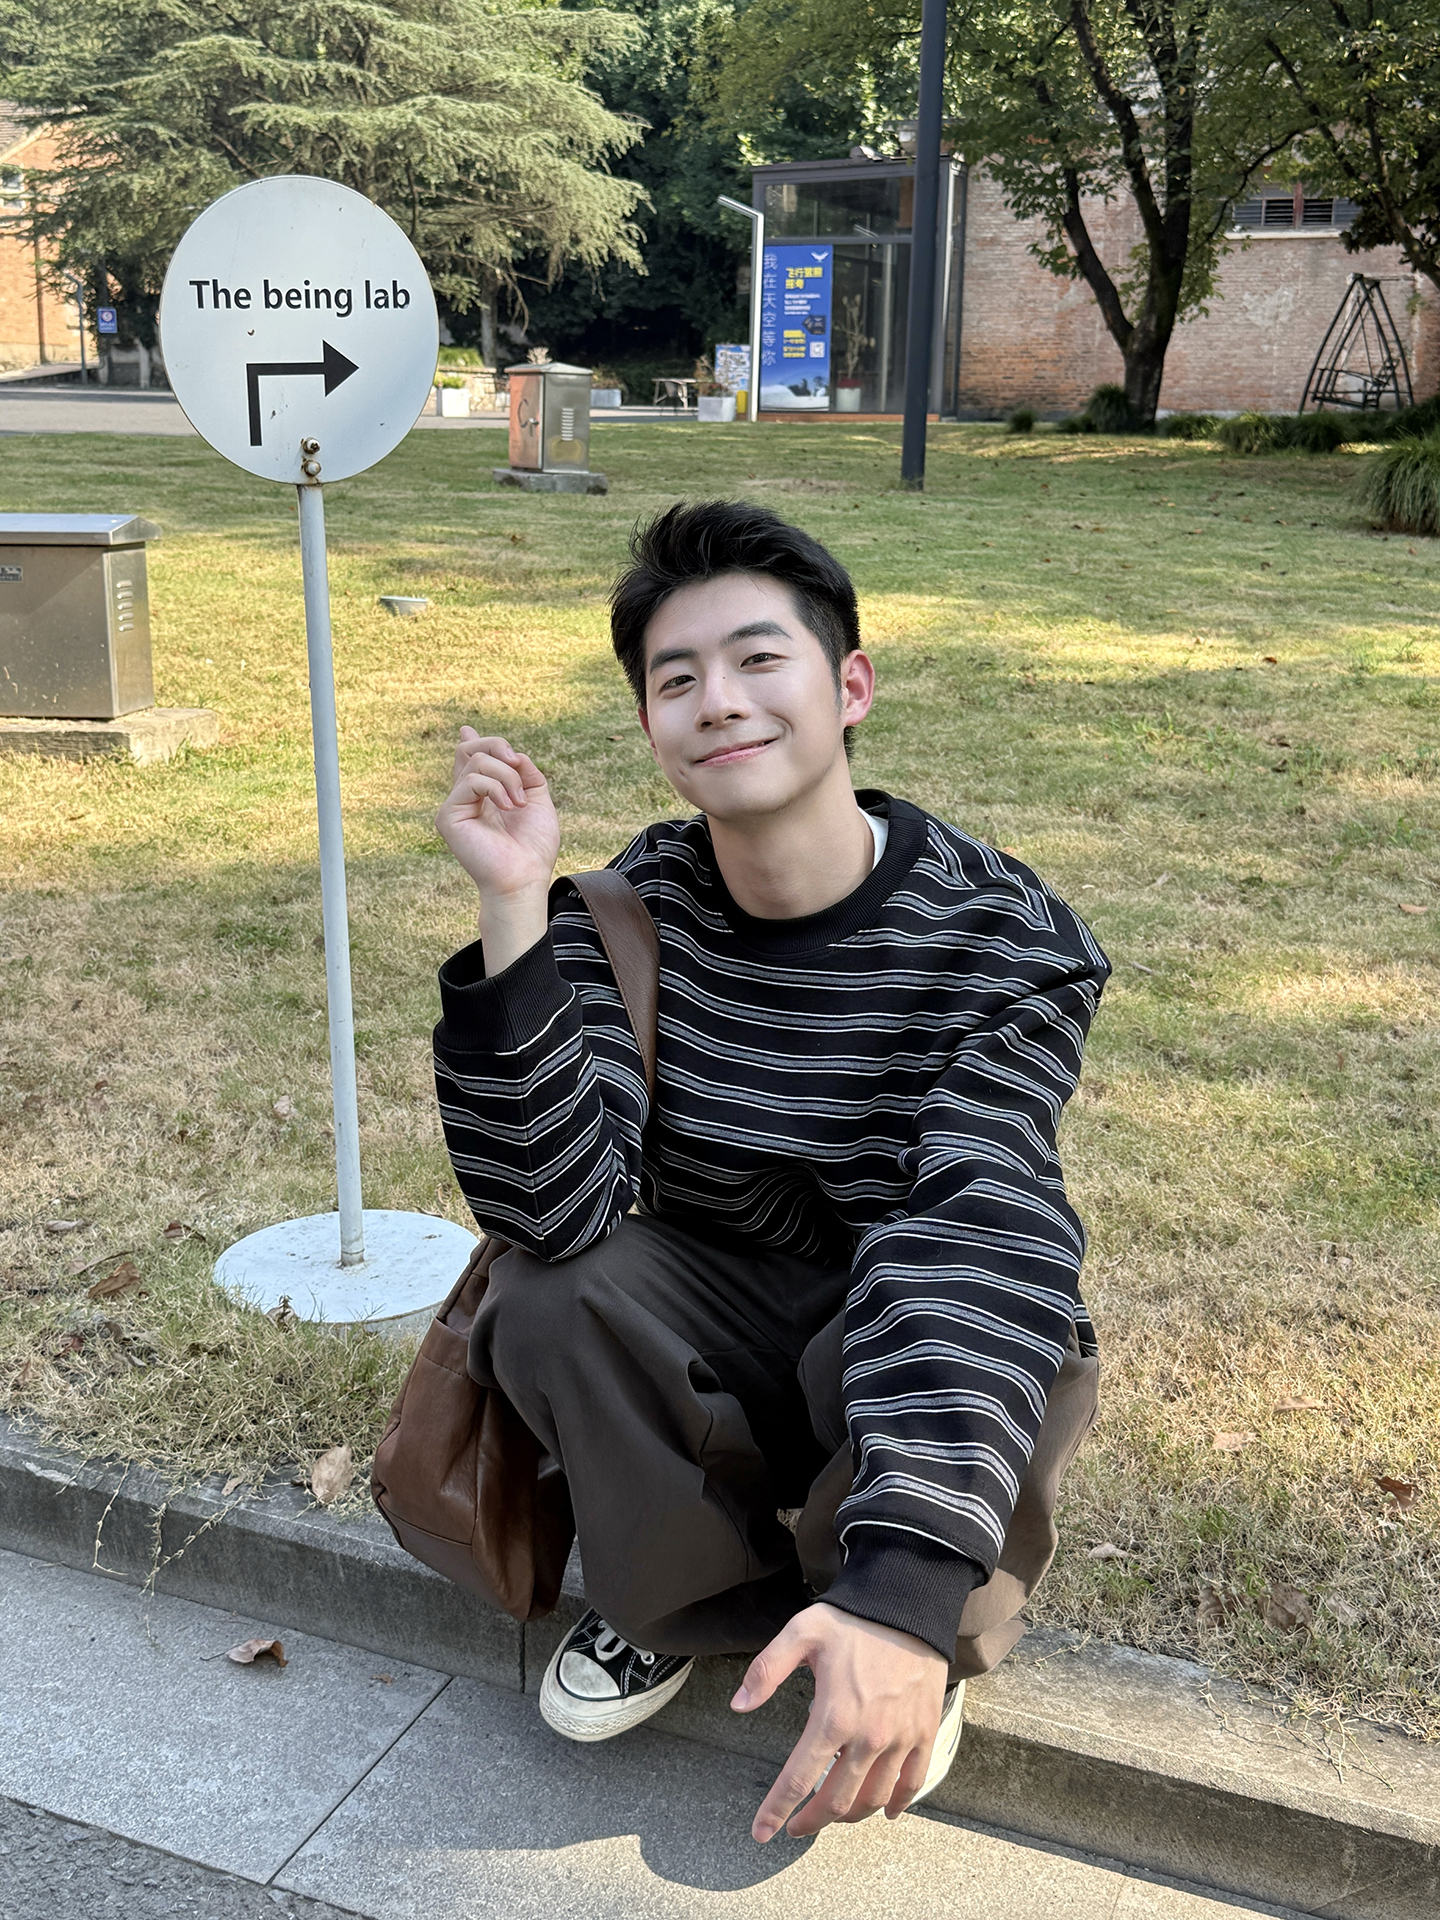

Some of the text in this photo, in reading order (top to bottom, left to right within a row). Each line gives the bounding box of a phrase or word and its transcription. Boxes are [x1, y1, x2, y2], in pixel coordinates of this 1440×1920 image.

[189, 279, 411, 318] The being lab
[761, 254, 778, 367] 我在天空等你
